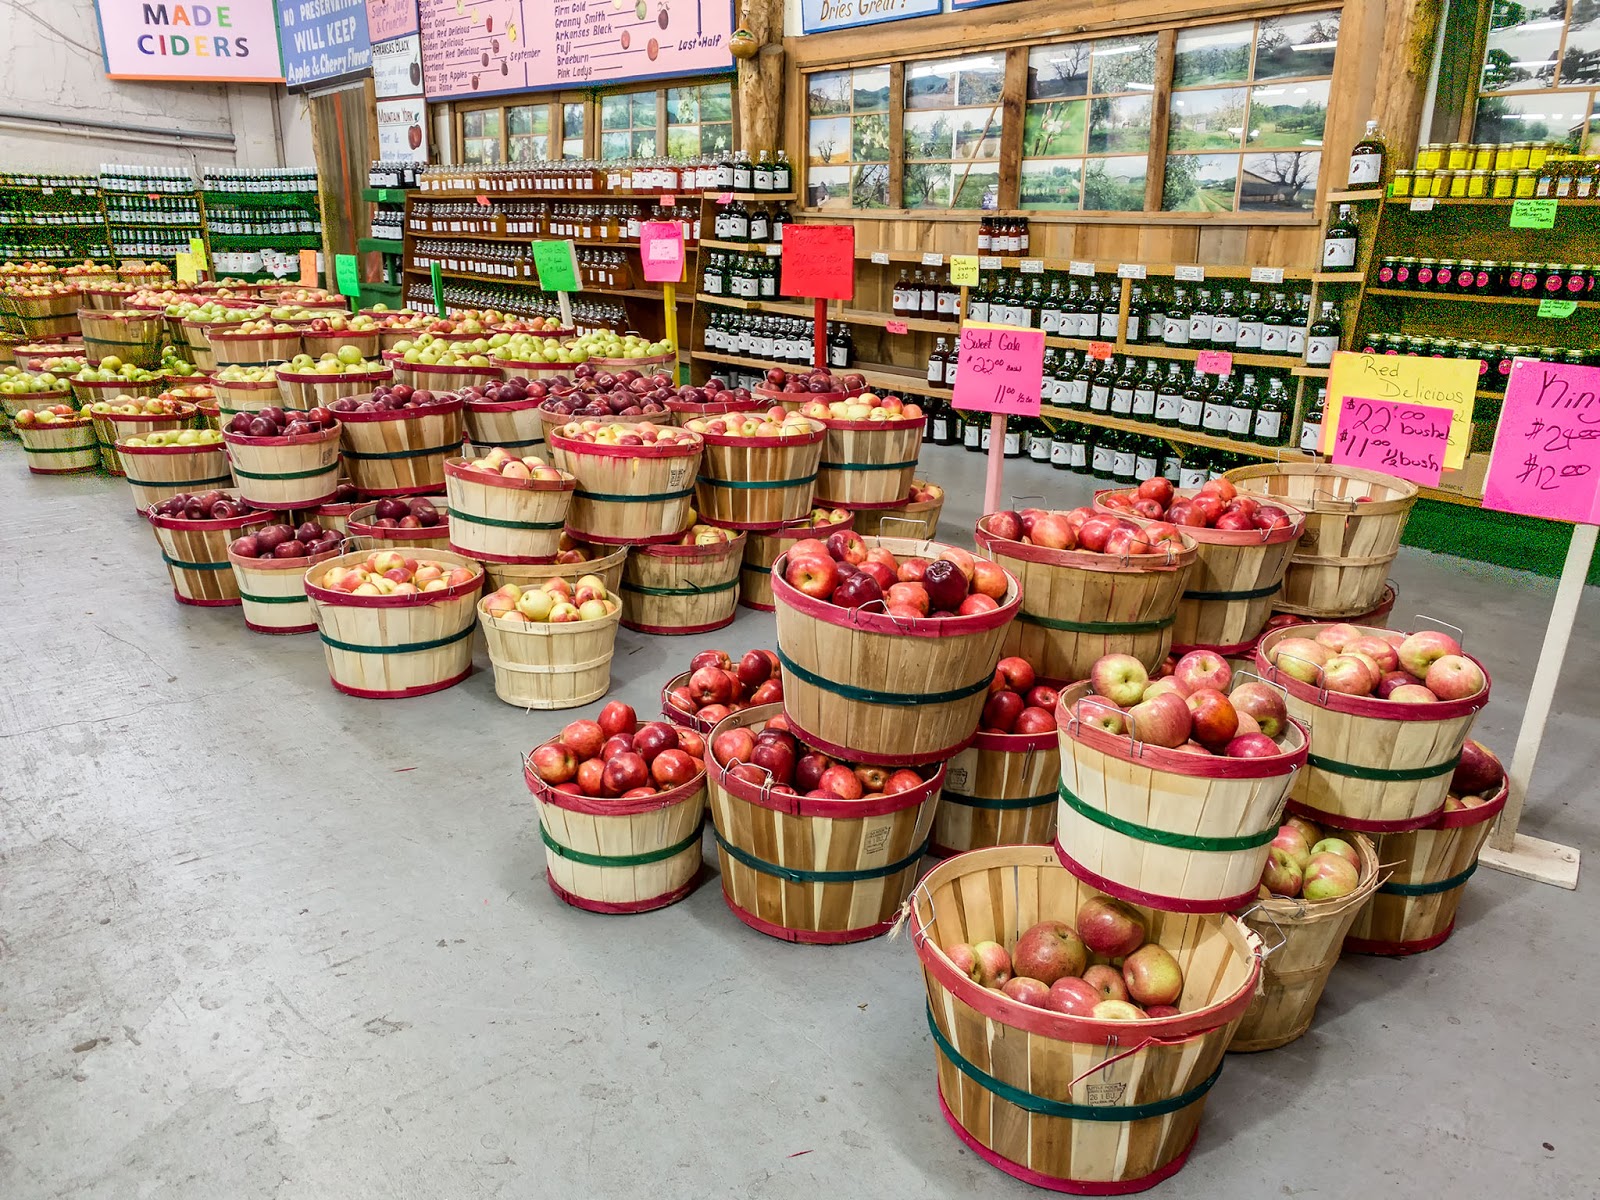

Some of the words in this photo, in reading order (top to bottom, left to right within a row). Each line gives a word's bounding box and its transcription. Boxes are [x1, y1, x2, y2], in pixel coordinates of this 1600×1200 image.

[142, 3, 232, 27] MADE
[283, 8, 295, 27] NO
[554, 5, 570, 16] Firm
[572, 3, 586, 13] Gold
[820, 0, 852, 21] Dries
[555, 15, 582, 29] Granny
[584, 12, 606, 25] Smith
[294, 26, 326, 54] WILL
[326, 16, 356, 46] KEEP
[449, 26, 470, 36] Delicious
[555, 26, 591, 41] Arkansas
[593, 23, 612, 36] Black
[137, 34, 249, 57] CIDERS
[440, 38, 464, 49] Delicious
[556, 41, 571, 55] Fuji
[678, 38, 697, 51] Last
[701, 34, 722, 48] Half
[457, 47, 480, 57] Delicious
[510, 49, 541, 62] September
[557, 53, 589, 66] Braeburn
[288, 60, 311, 84] Apple
[320, 54, 347, 74] Cherry
[348, 47, 370, 67] Flavor
[557, 68, 570, 79] Pink
[573, 66, 592, 80] Ladys
[450, 70, 468, 82] Apples
[963, 331, 993, 350] Sweet
[998, 333, 1021, 351] Gala
[1360, 355, 1400, 377] Red
[1377, 378, 1464, 404] Delicious
[1535, 370, 1600, 424] Kin
[1400, 422, 1450, 440] bushel
